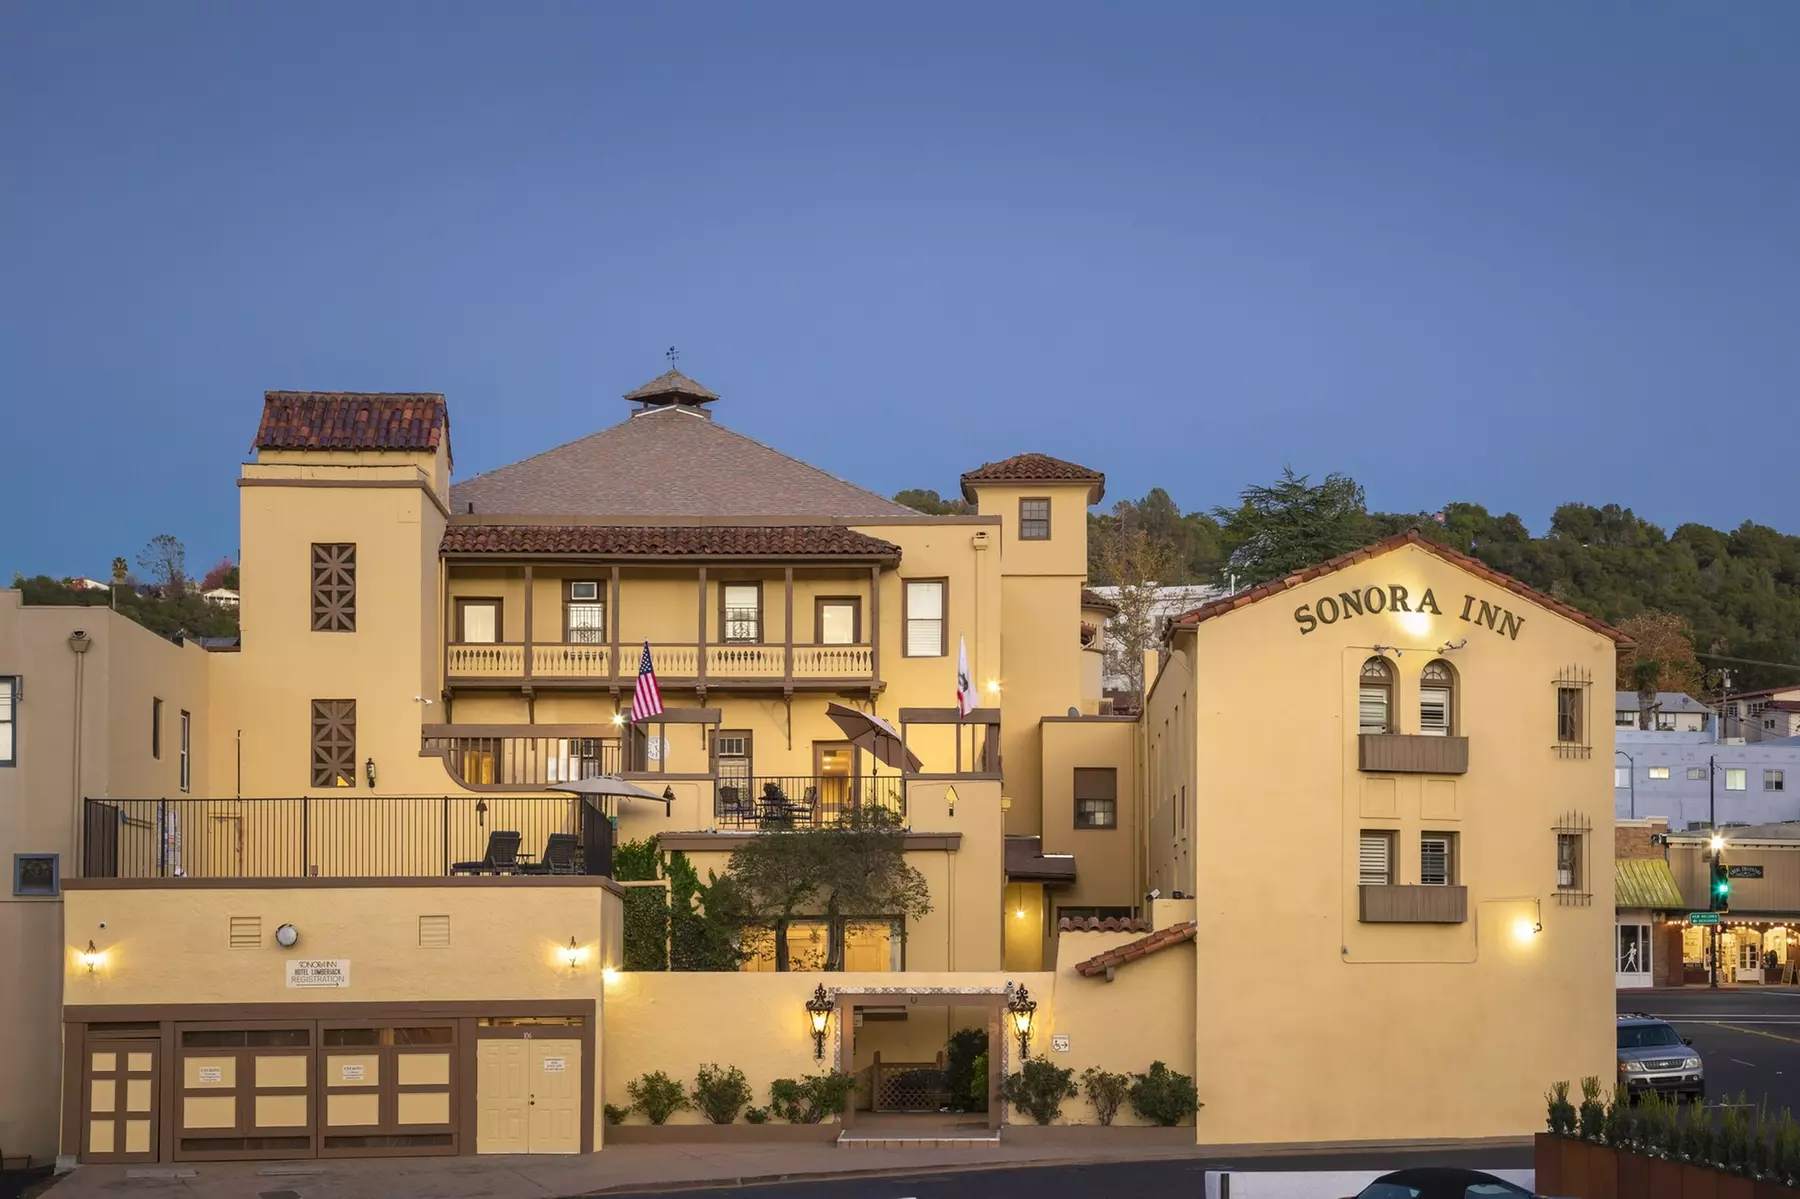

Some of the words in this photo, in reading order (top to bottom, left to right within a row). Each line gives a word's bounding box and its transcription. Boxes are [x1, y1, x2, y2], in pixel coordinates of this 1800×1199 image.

[1294, 583, 1442, 635] SONORA
[1459, 594, 1525, 641] INN
[294, 968, 309, 976] HOTEL
[311, 968, 341, 976] LUMBERJACK
[291, 975, 345, 983] REGISTRATION
